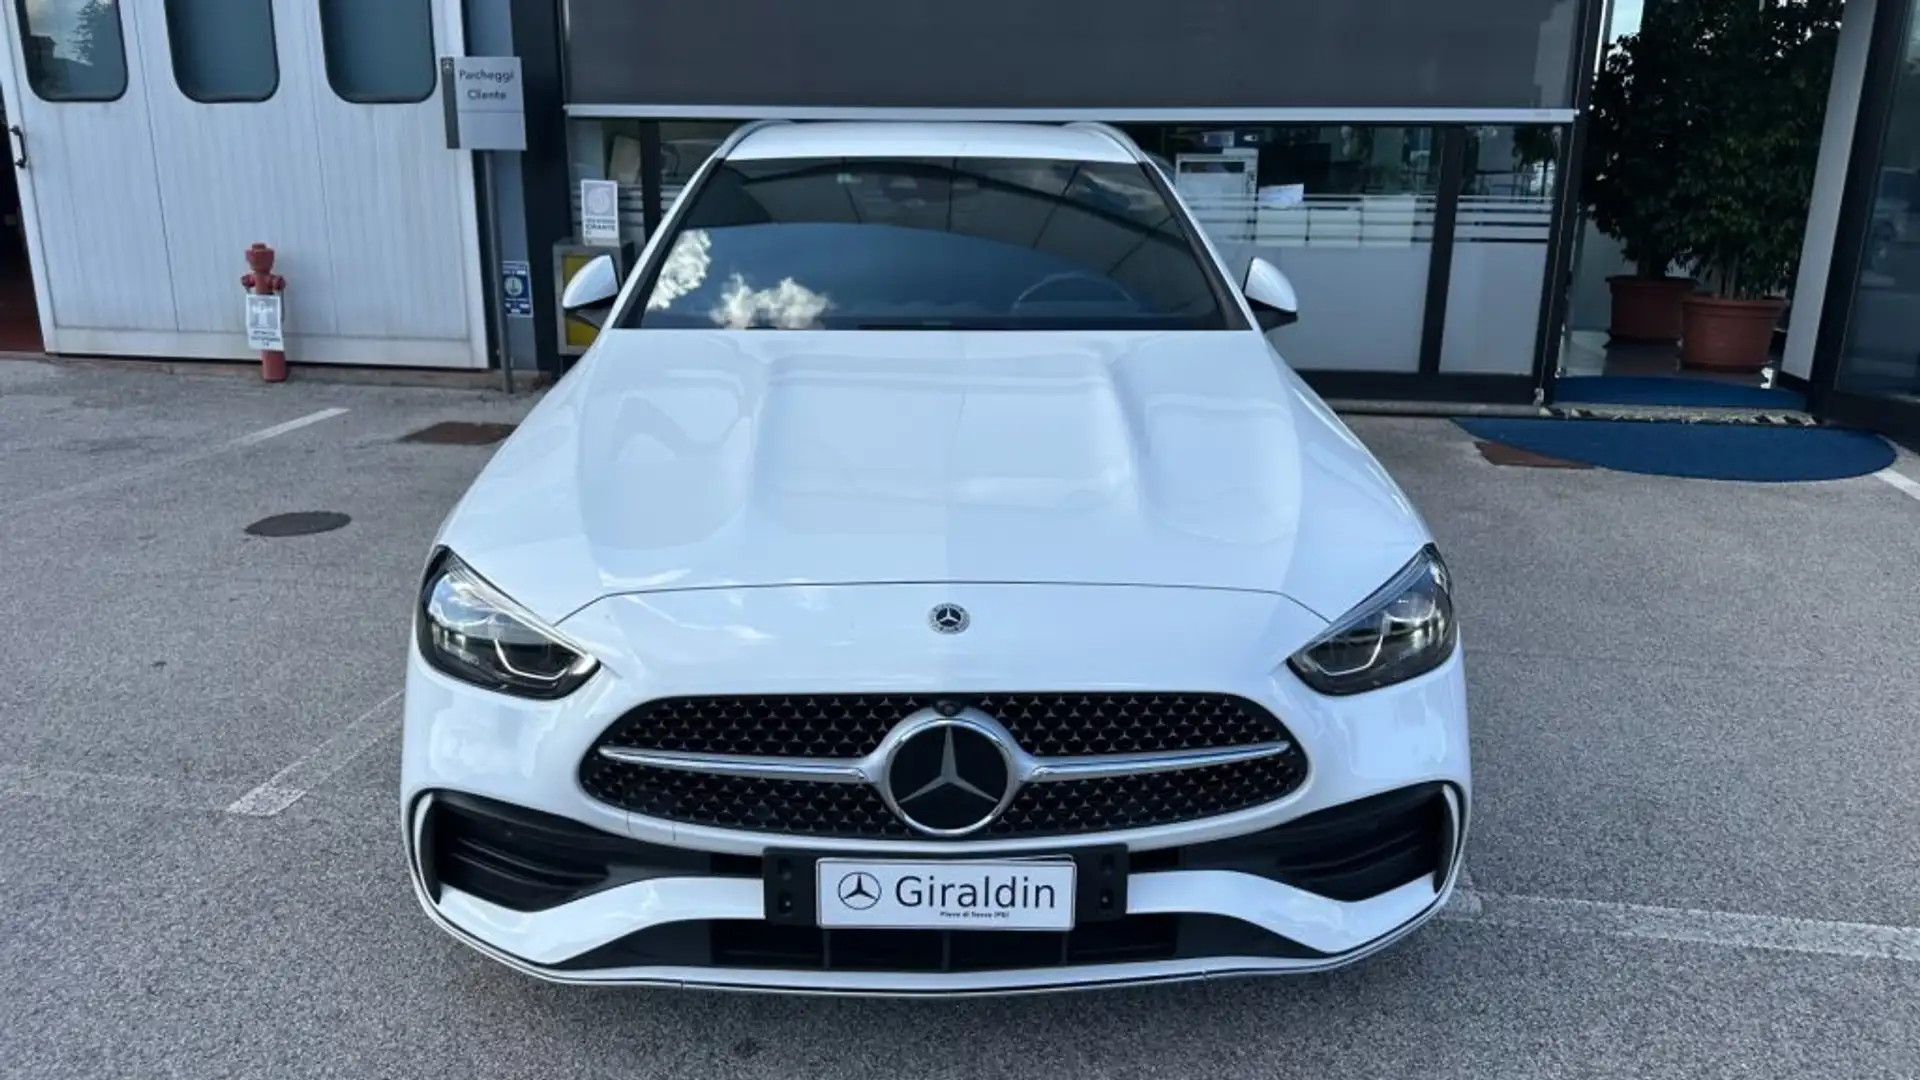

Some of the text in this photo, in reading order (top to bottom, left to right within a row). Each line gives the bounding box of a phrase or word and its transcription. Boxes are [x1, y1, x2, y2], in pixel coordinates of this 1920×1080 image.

[459, 68, 514, 83] Parcheggi
[467, 89, 506, 100] Cliente
[895, 876, 1056, 908] Giraldin
